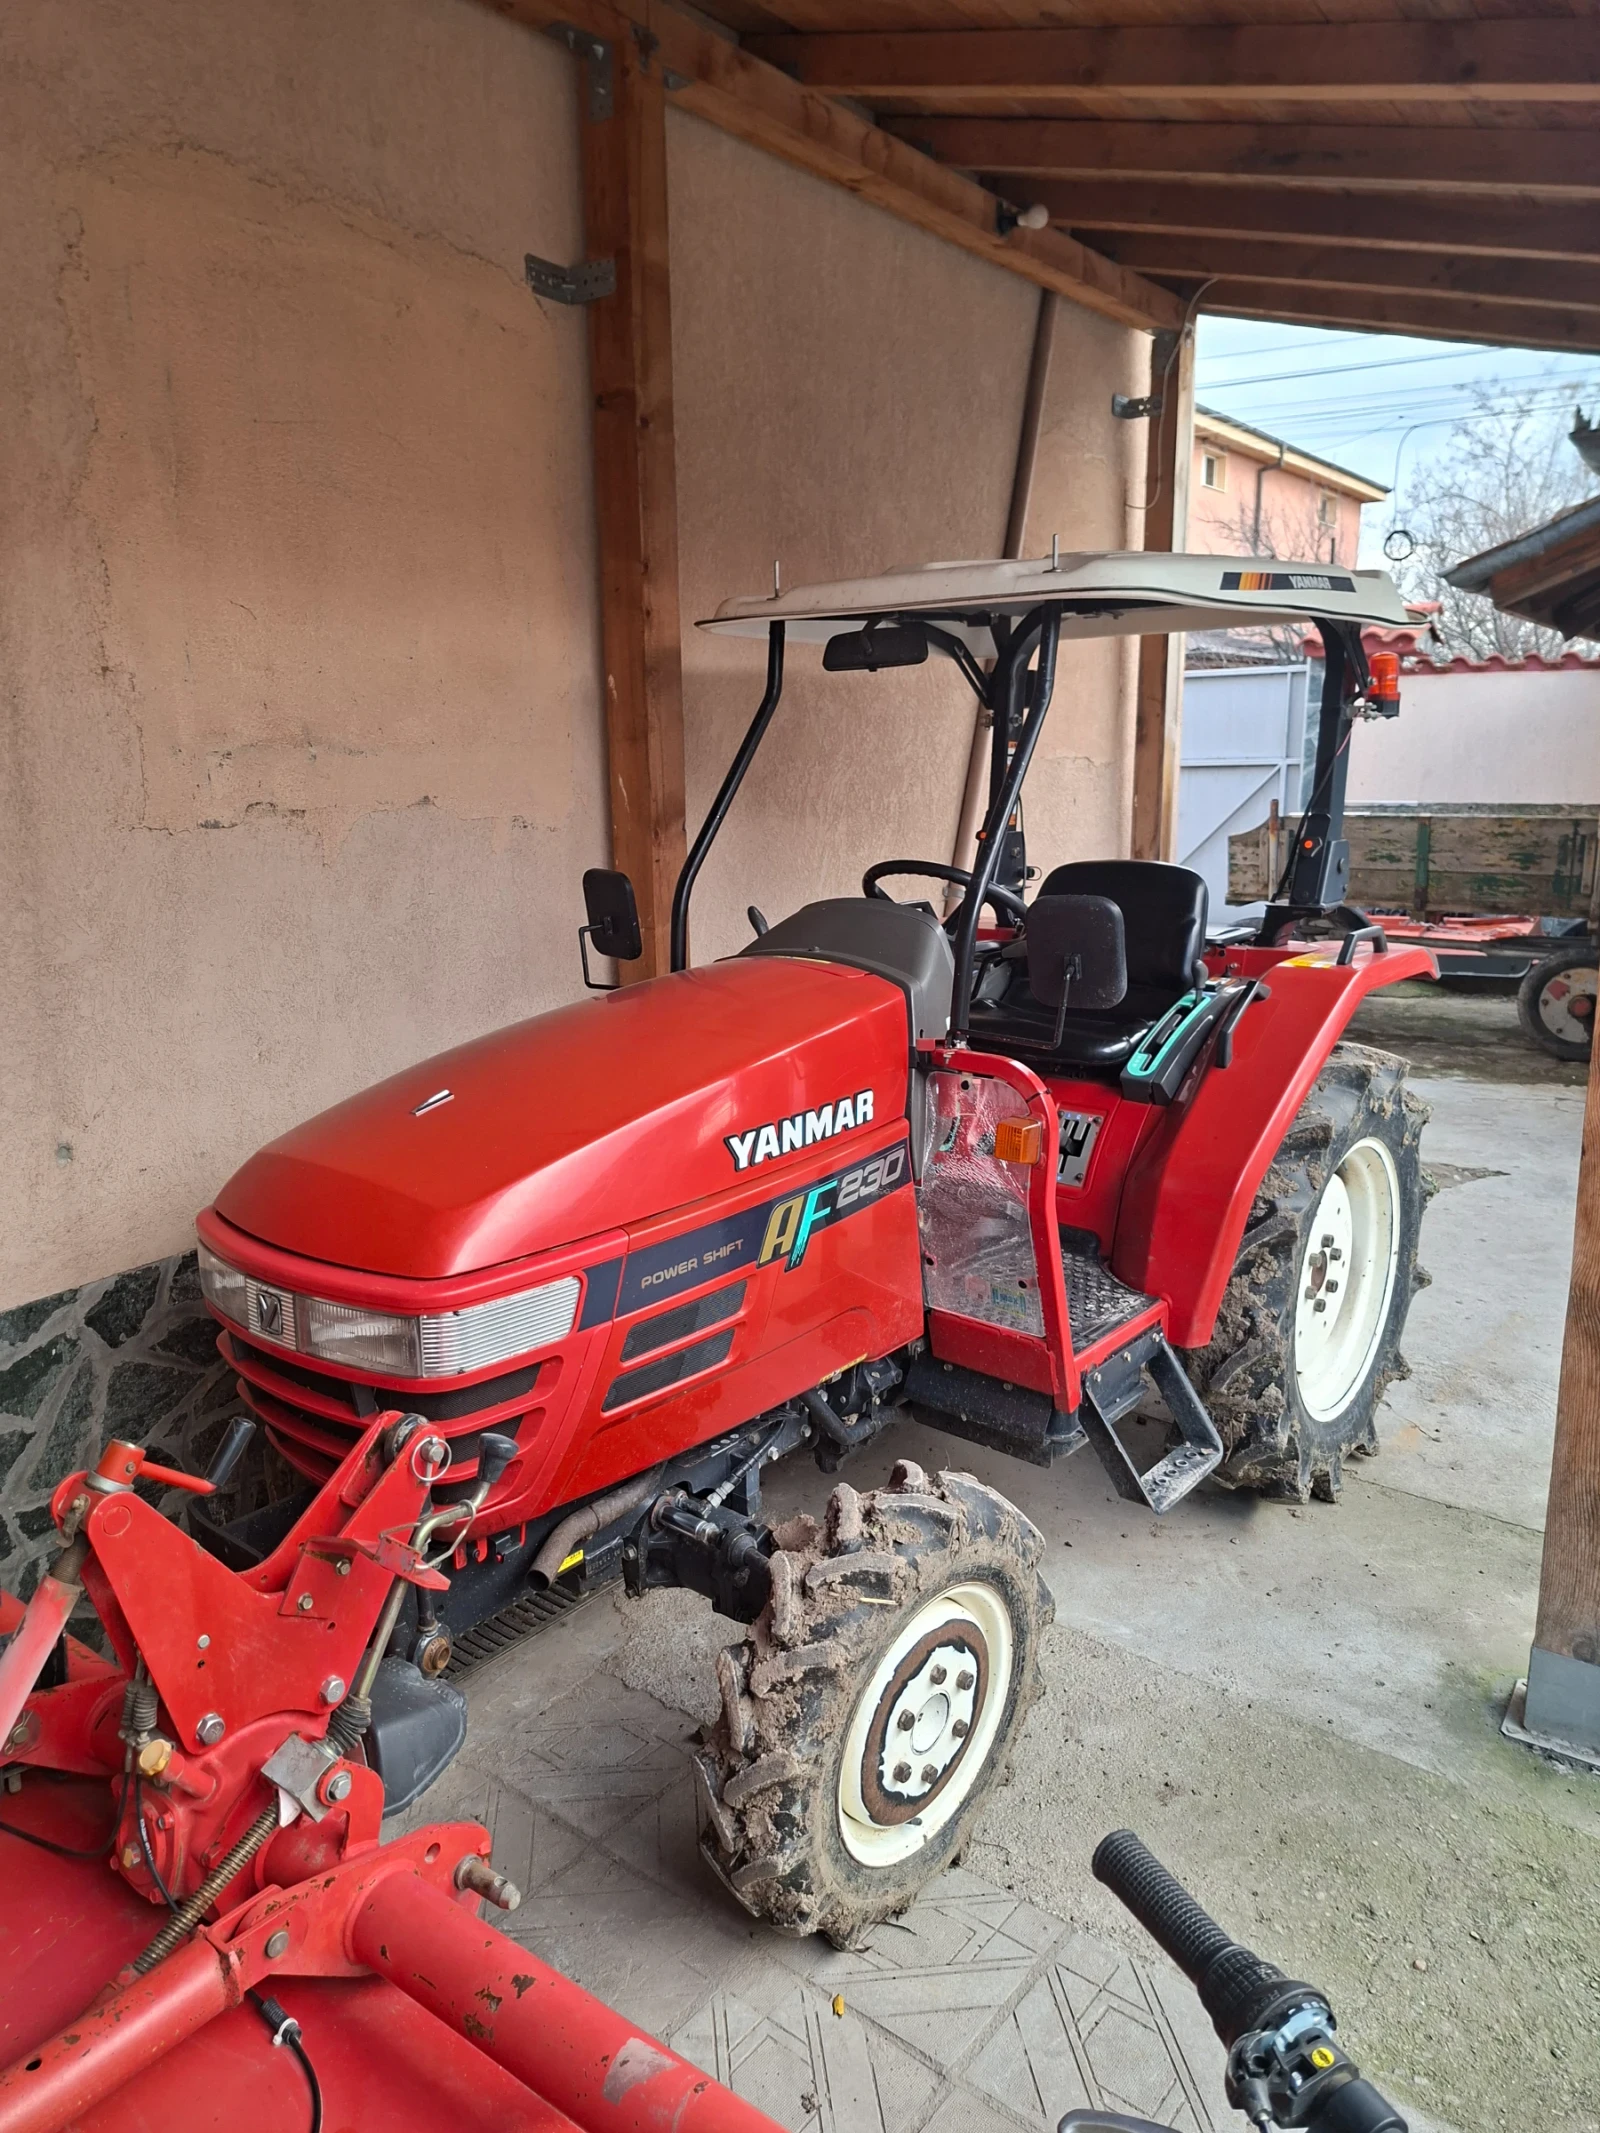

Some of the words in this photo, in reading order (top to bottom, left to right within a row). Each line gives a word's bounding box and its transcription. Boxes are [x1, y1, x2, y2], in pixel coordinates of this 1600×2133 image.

[1288, 575, 1332, 590] YANMAR
[725, 1089, 875, 1171] YANMAR
[641, 1257, 698, 1289] POWER
[702, 1238, 744, 1265] SHIFT
